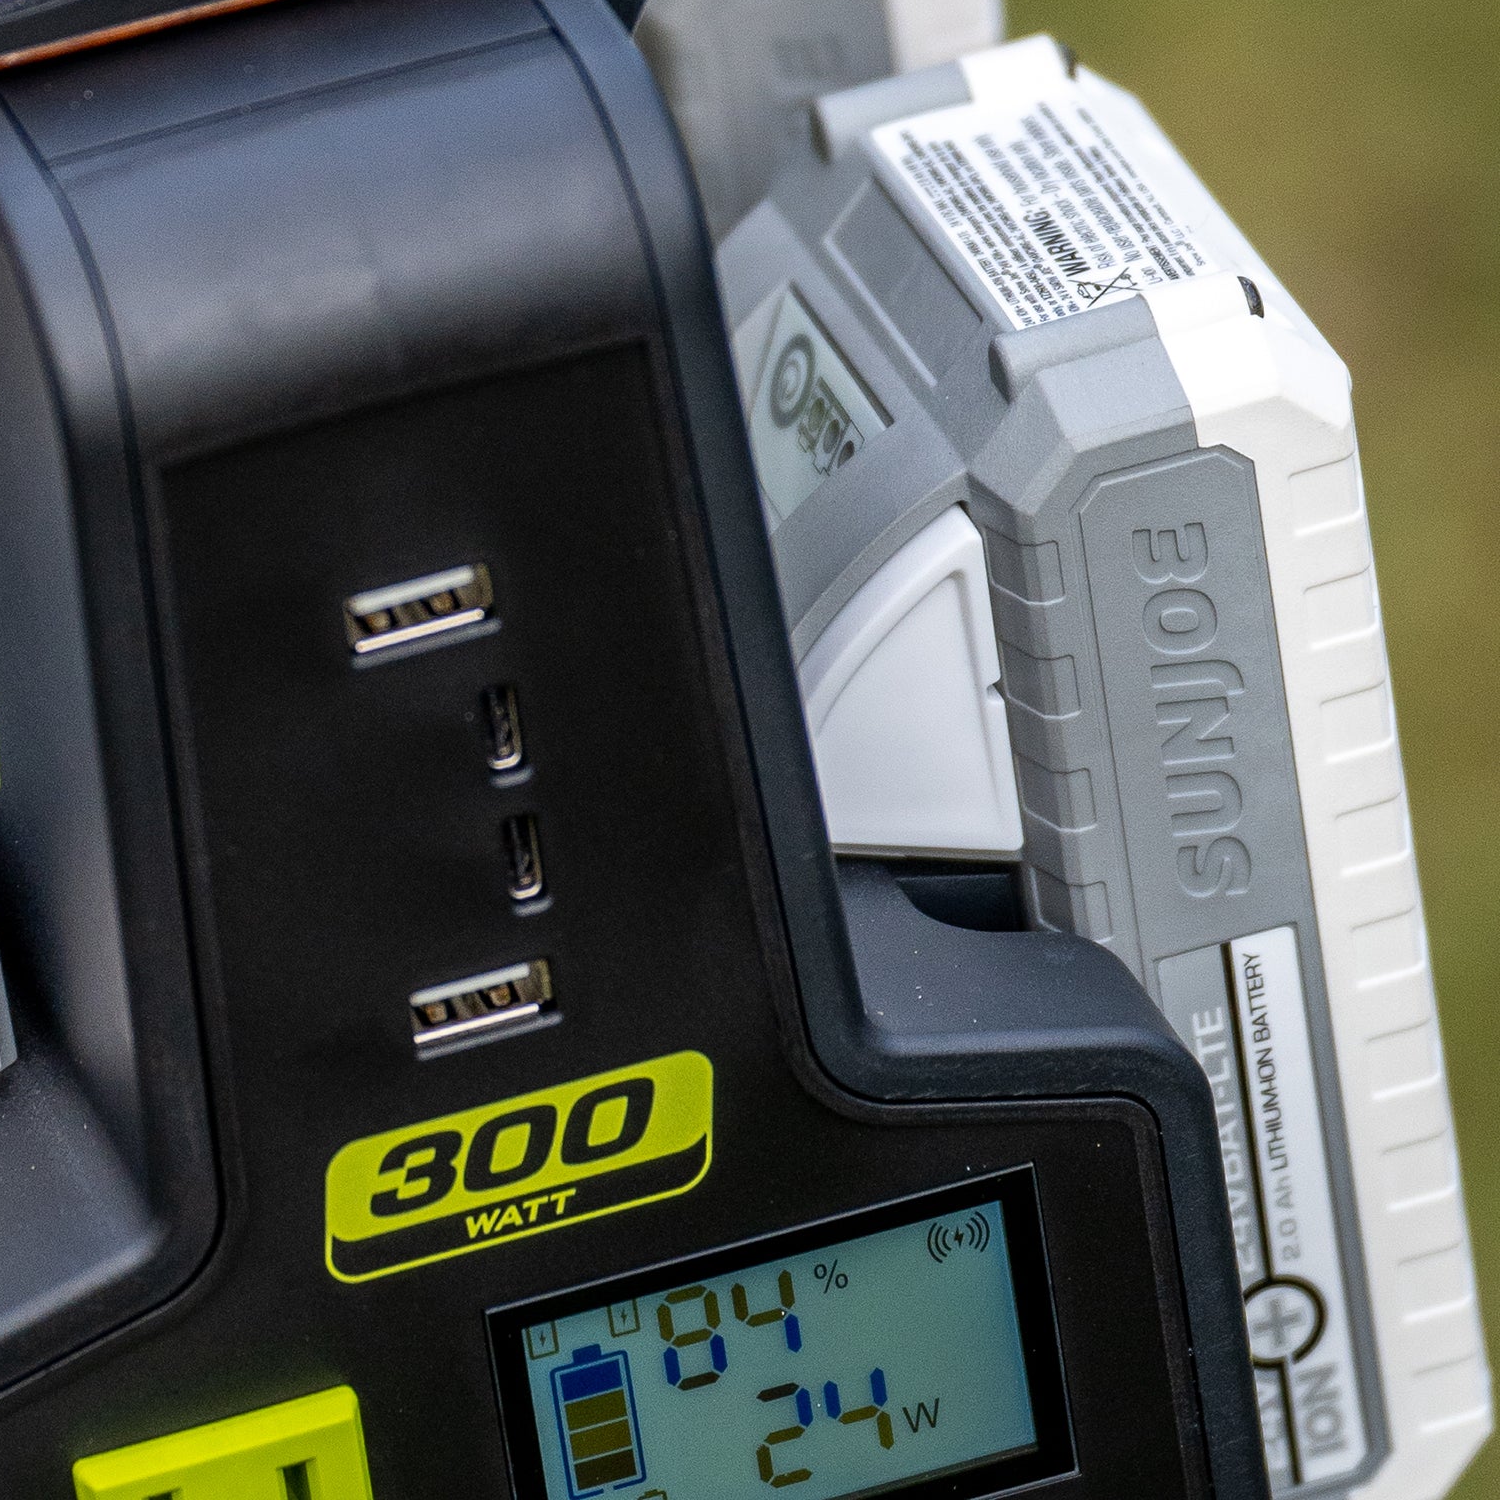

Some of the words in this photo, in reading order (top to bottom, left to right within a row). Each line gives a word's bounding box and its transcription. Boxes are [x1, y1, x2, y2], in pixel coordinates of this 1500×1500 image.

[1048, 197, 1082, 220] shock
[1016, 206, 1094, 277] WARNING:
[1063, 217, 1101, 245] electric
[1082, 242, 1107, 253] of
[1087, 250, 1120, 270] Risk
[1118, 249, 1145, 263] No
[1135, 264, 1165, 285] Li-ion
[1031, 304, 1046, 313] use
[1035, 313, 1052, 322] For
[1131, 520, 1253, 901] SUNJOE
[1242, 952, 1270, 1043] BATTERY
[1255, 1044, 1288, 1172] LITHIUM-ION
[369, 1076, 656, 1218] 300
[465, 1188, 577, 1239] WATT
[1273, 1175, 1294, 1212] Ah
[656, 1269, 803, 1392] 84
[813, 1258, 849, 1295] %
[756, 1367, 895, 1488] 24
[902, 1397, 941, 1434] W
[1293, 1361, 1350, 1456] ION
